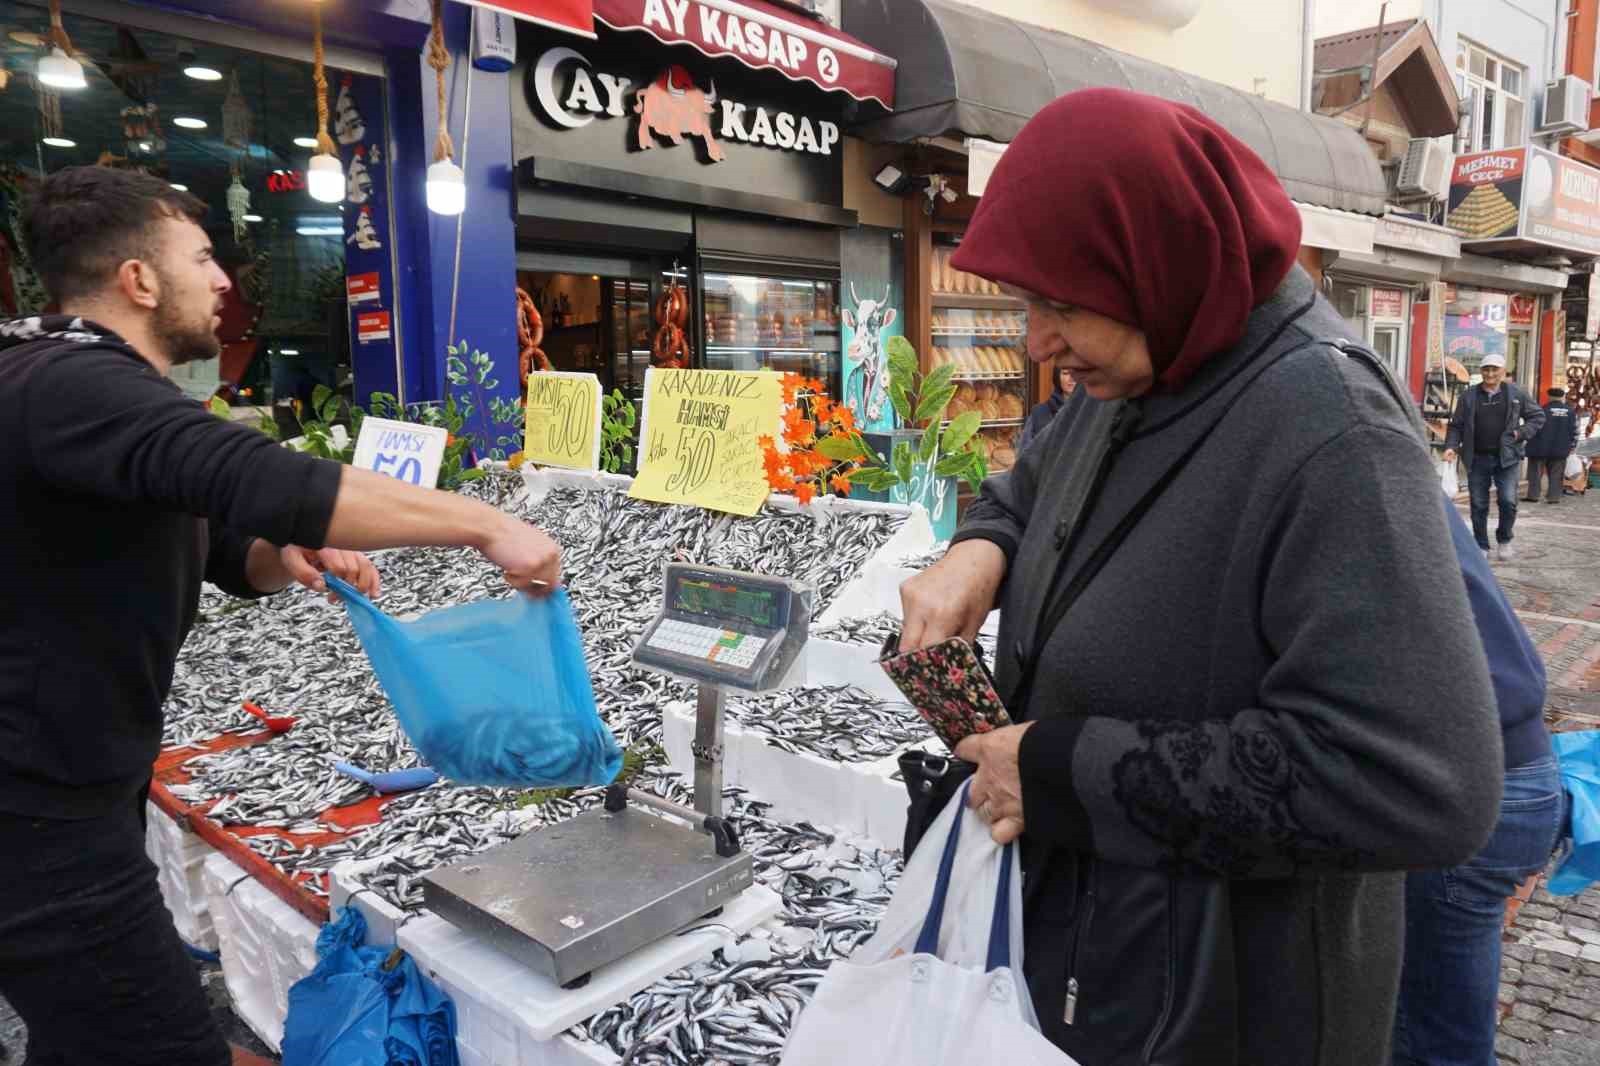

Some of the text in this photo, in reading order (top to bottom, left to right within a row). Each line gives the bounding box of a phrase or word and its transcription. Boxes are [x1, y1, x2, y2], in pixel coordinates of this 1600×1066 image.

[643, 0, 689, 36] AY
[699, 5, 808, 70] KASAP
[720, 99, 839, 155] KASAP
[1458, 156, 1518, 176] MEHMET
[548, 378, 591, 458] 50
[665, 427, 716, 496] 50
